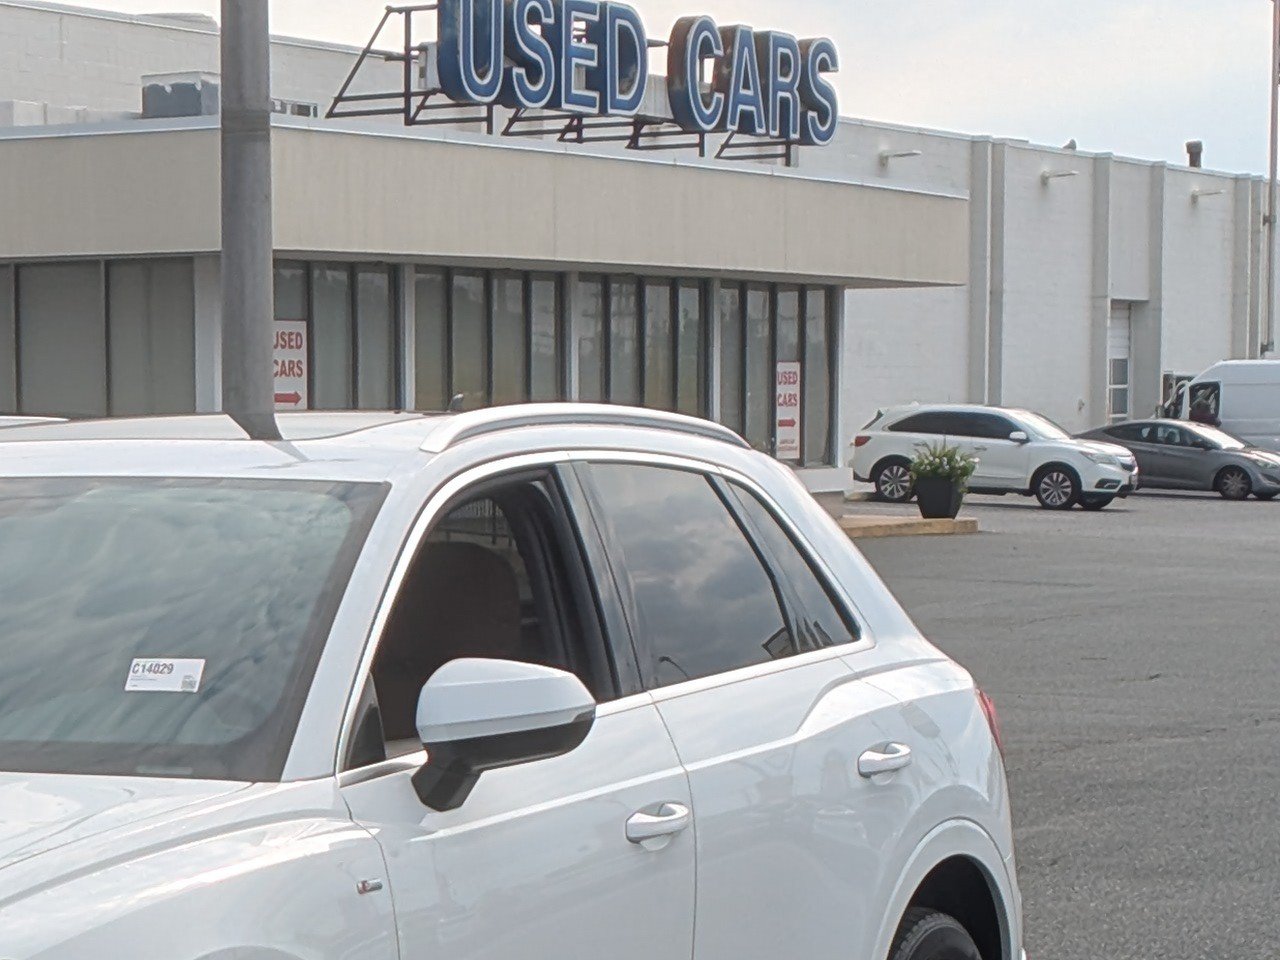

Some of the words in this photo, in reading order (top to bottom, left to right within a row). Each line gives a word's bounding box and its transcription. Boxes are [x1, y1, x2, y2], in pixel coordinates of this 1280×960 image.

[459, 0, 650, 116] USED
[687, 15, 839, 146] CARS
[777, 371, 798, 386] USED
[777, 393, 798, 407] CARS
[132, 662, 174, 675] C14029
